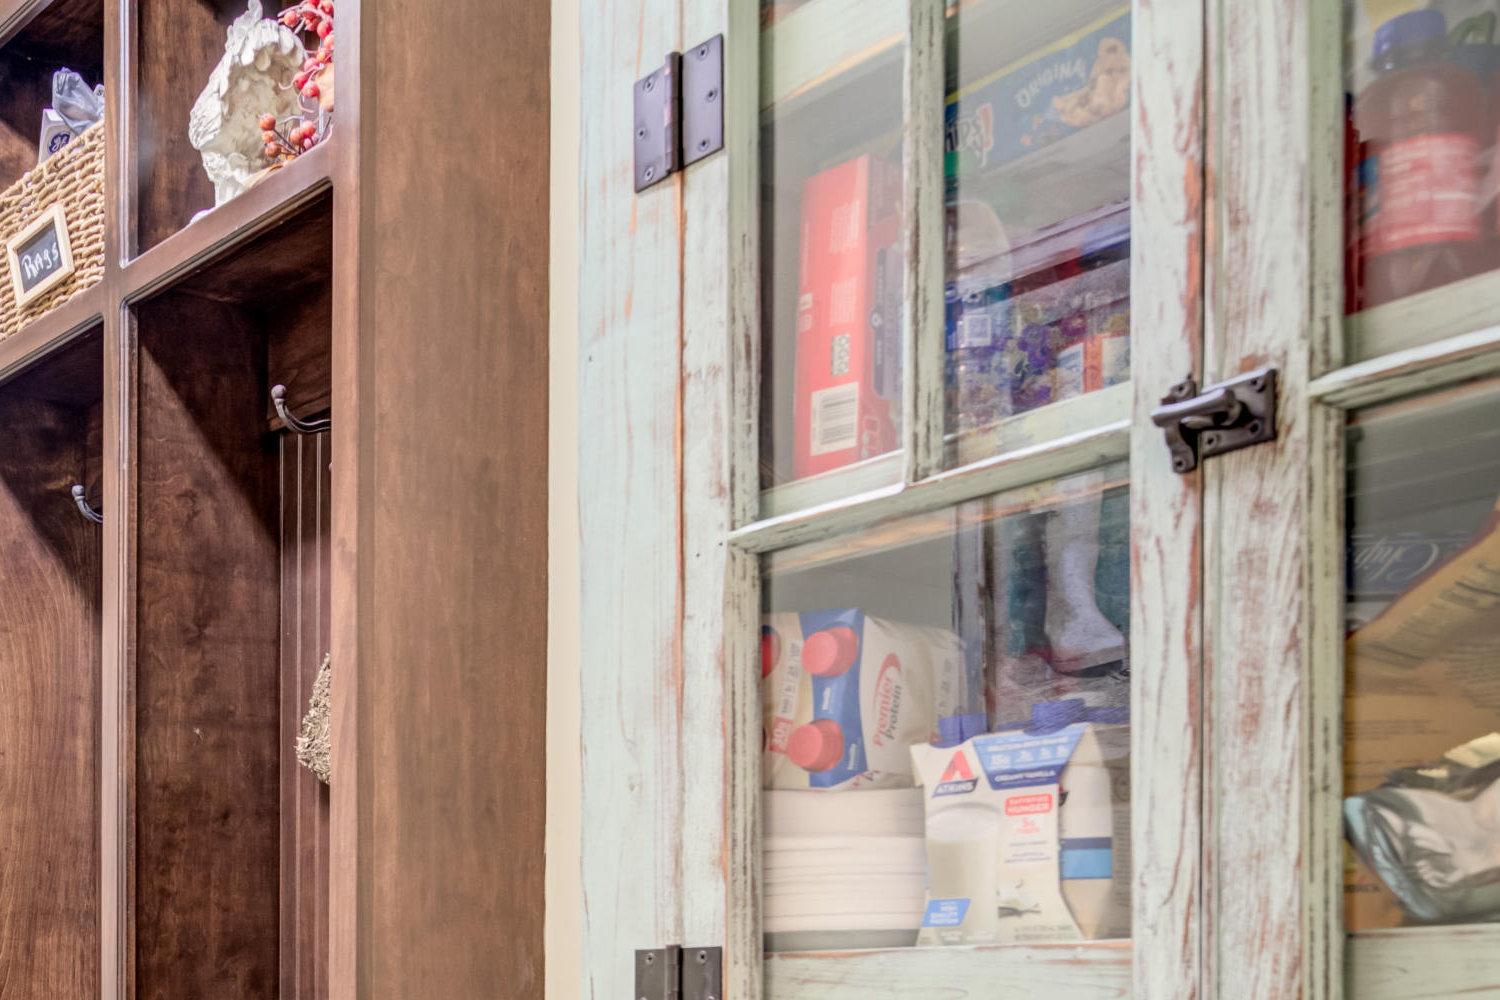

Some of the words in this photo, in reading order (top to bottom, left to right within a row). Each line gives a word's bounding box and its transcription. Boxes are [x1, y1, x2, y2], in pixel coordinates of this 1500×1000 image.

[22, 242, 58, 279] Rags
[873, 676, 893, 747] Premier
[886, 685, 902, 740] Protein
